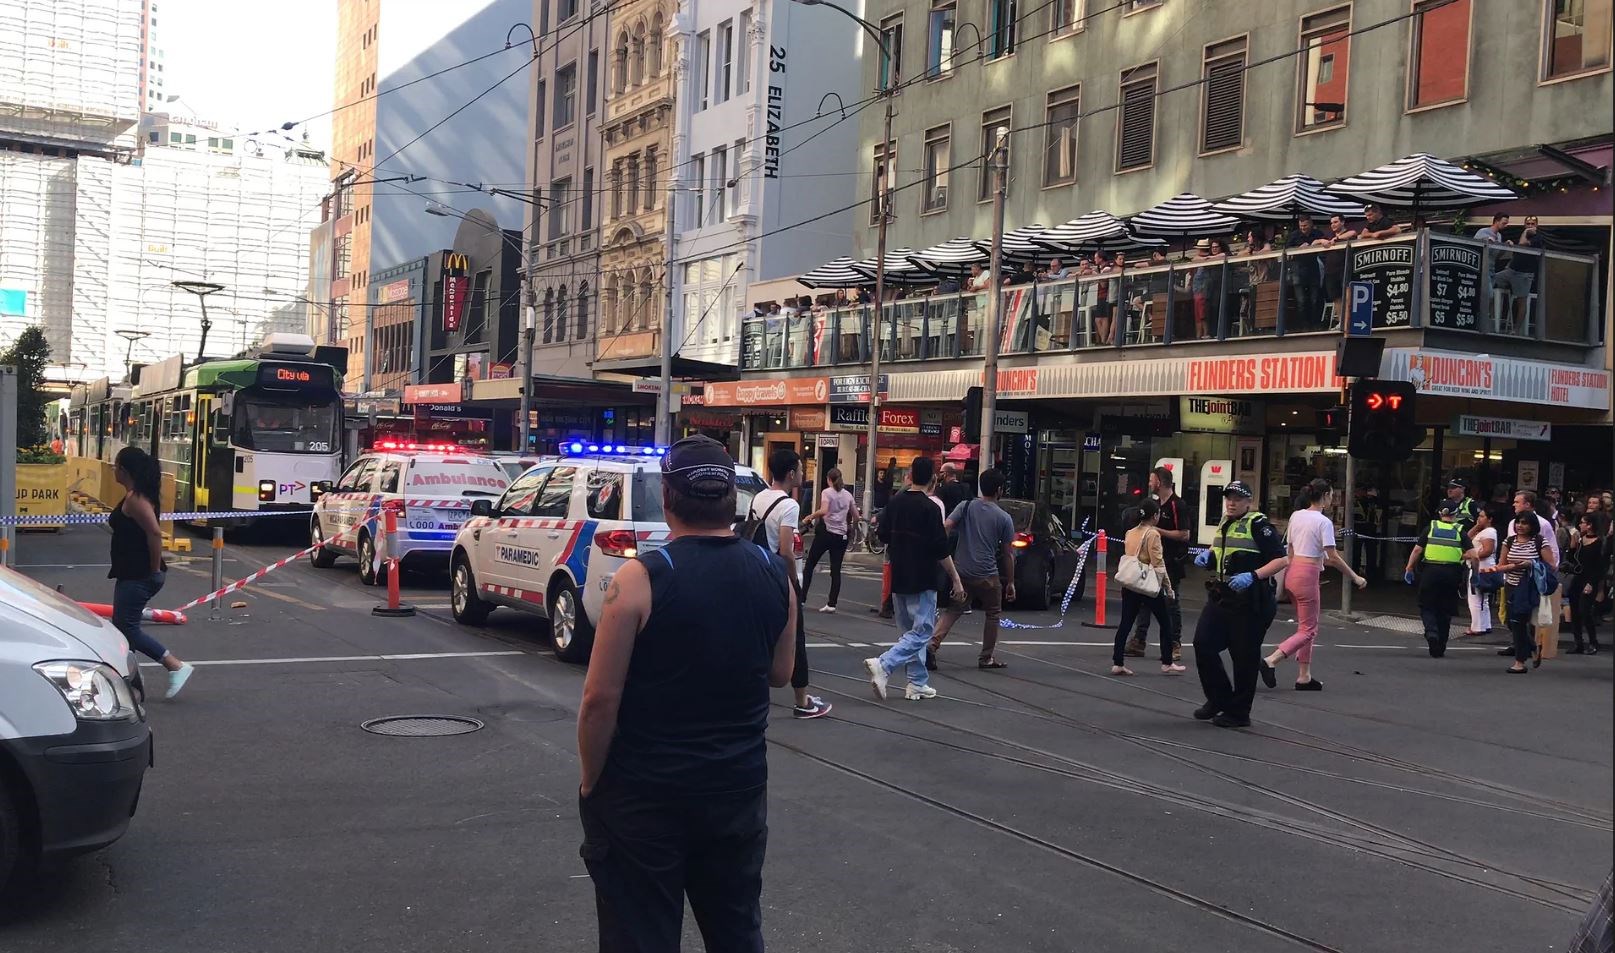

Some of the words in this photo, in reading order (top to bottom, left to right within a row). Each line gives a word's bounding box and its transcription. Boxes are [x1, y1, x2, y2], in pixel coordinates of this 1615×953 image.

[769, 45, 786, 73] 25
[764, 85, 782, 179] ELIZABETH
[1357, 249, 1409, 267] SMIRNOFF
[1434, 248, 1476, 265] SMIRNOFF
[1386, 283, 1408, 298] $4.80
[1436, 283, 1448, 296] $7
[1457, 286, 1476, 299] $4.80
[1352, 285, 1369, 313] P
[1386, 311, 1408, 325] $5.50
[1434, 311, 1445, 324] $5
[1456, 314, 1475, 326] $5.50
[277, 368, 296, 381] City
[296, 369, 310, 381] via
[1190, 359, 1256, 391] FLINDERS
[1260, 356, 1327, 389] STATION
[1432, 356, 1492, 389] DUNCAN'S
[1551, 368, 1580, 387] FLINDERS
[1582, 371, 1608, 390] STATION
[1551, 386, 1569, 403] HOTEL
[836, 408, 869, 422] Raffle
[882, 410, 915, 425] Forex
[309, 442, 328, 451] 205
[413, 473, 507, 489] Ambulance
[32, 488, 59, 500] PARK
[416, 521, 434, 529] 000
[501, 546, 539, 566] PARAMEDIC
